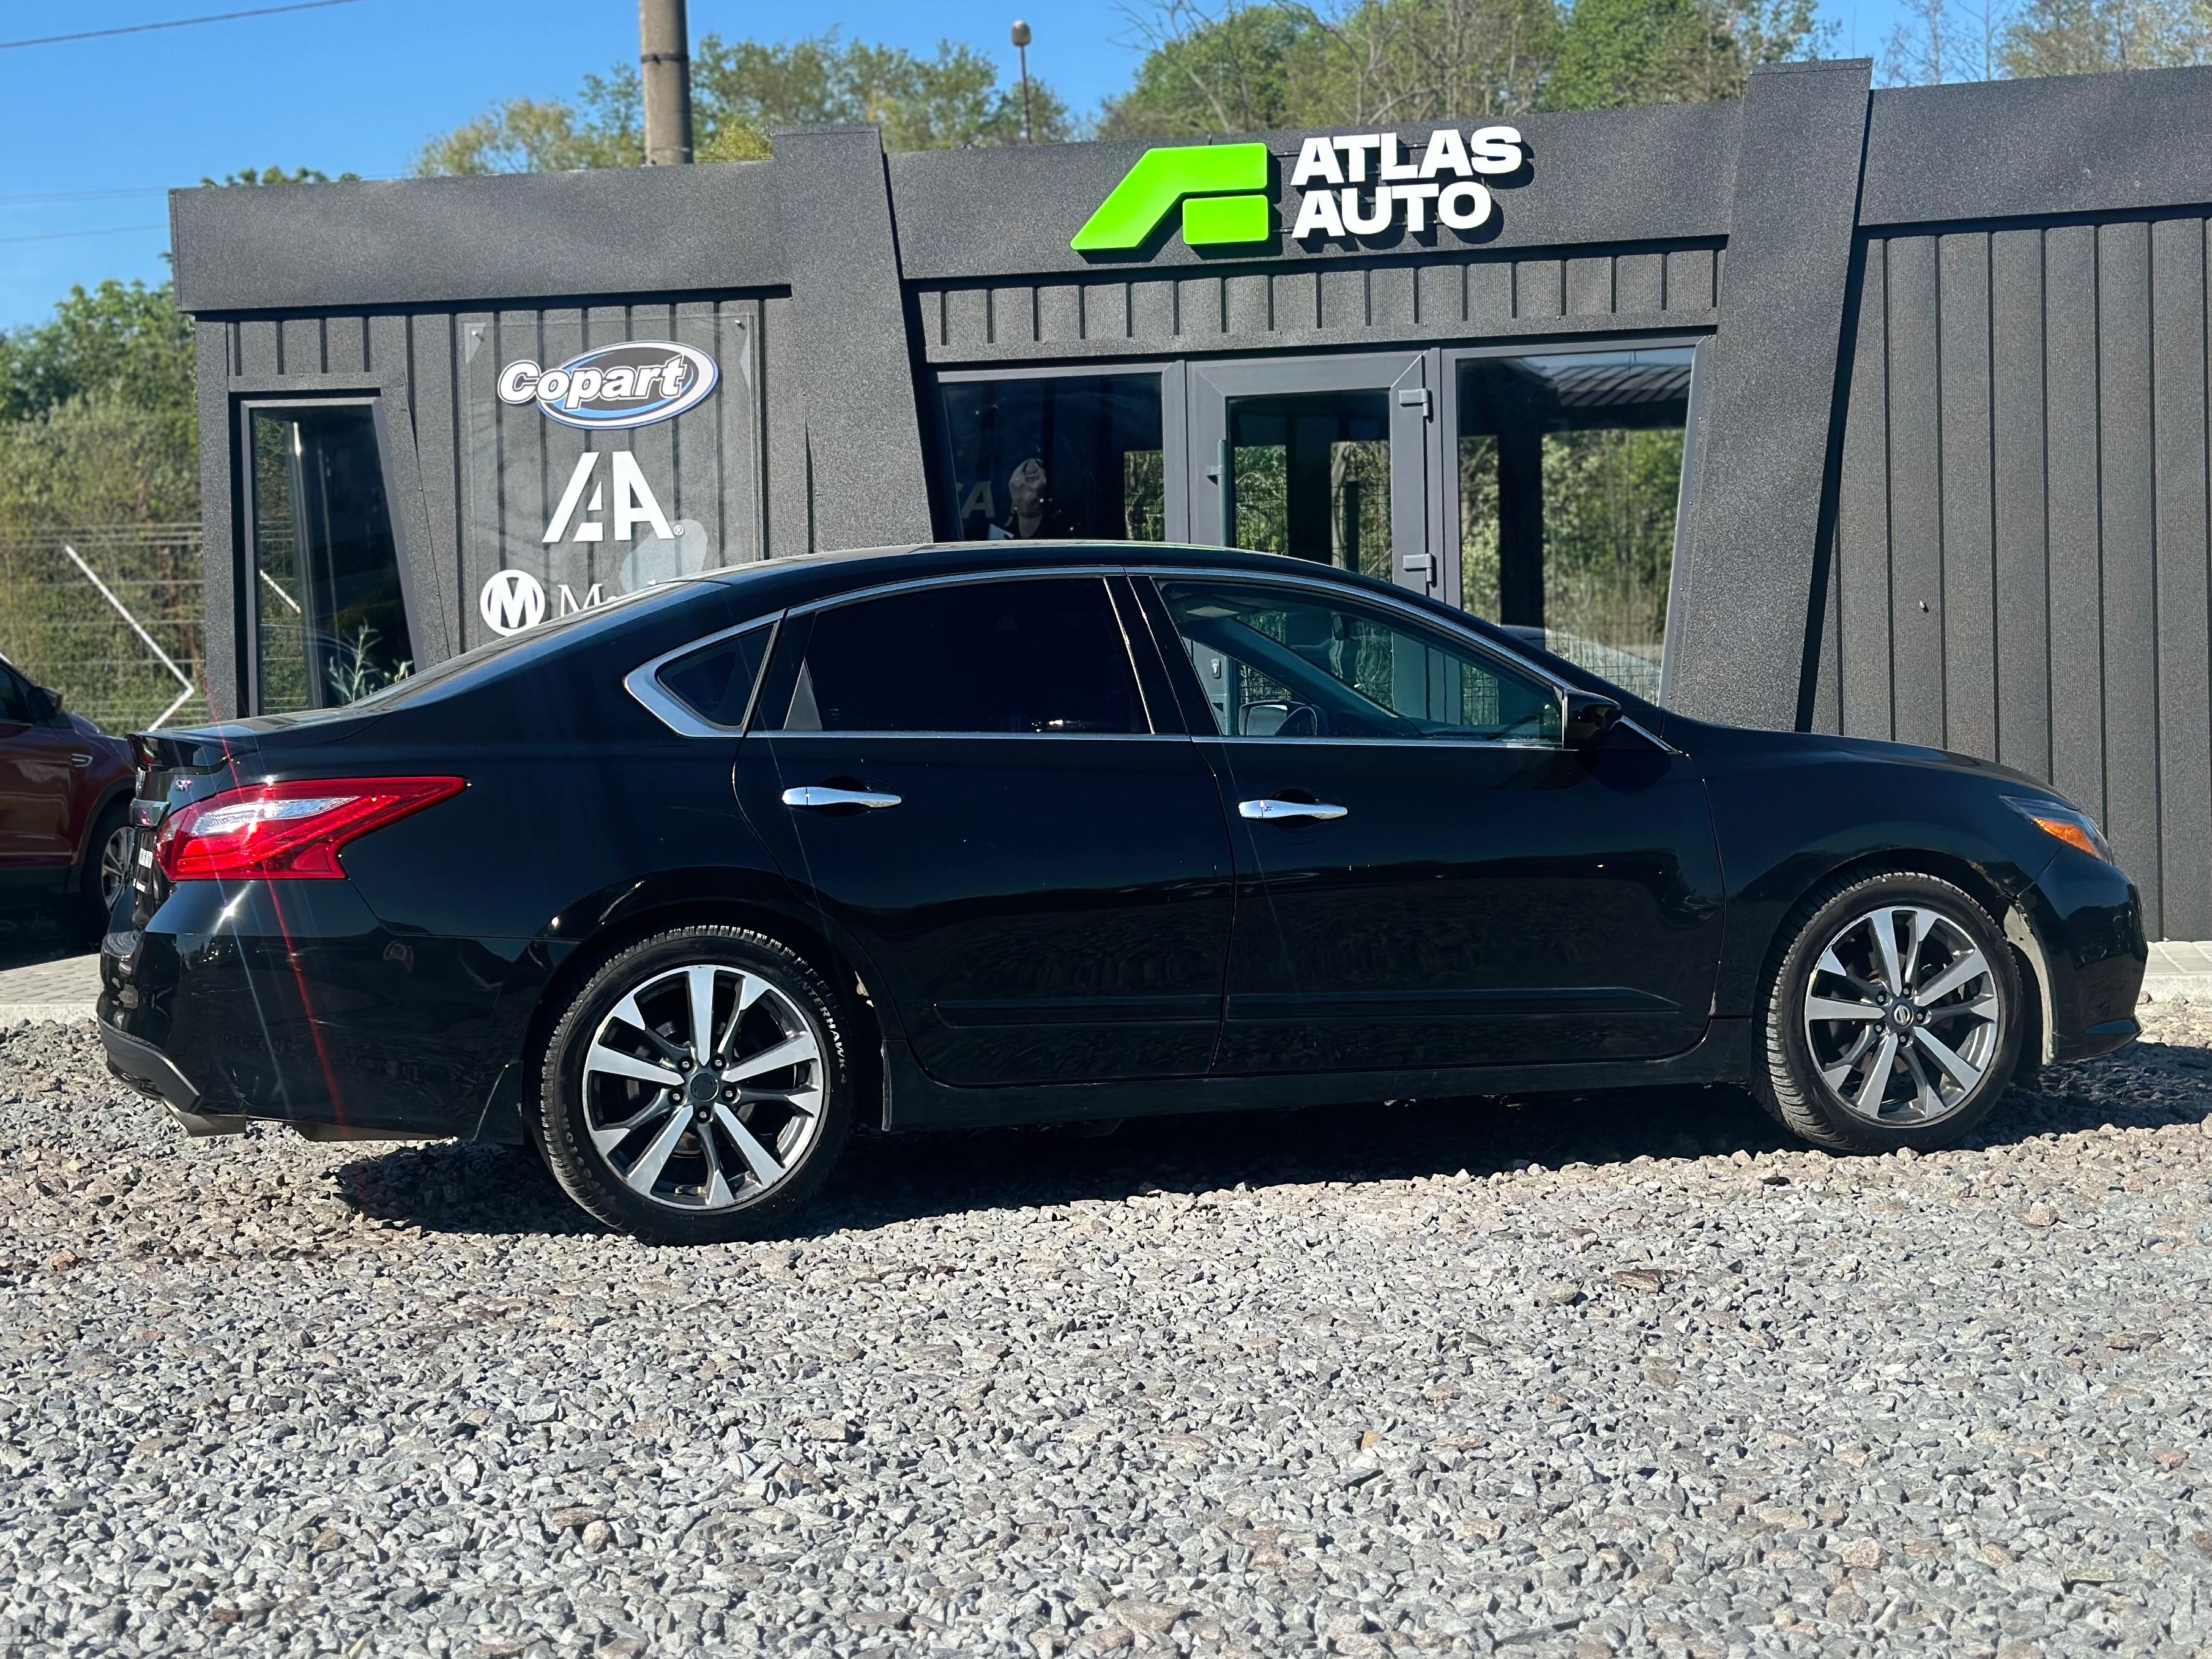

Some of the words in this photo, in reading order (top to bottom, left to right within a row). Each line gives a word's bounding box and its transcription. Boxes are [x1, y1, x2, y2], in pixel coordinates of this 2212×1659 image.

[1290, 126, 1522, 186] ATLAS
[1291, 182, 1492, 239] AUTO
[497, 354, 687, 411] Copart
[781, 964, 847, 1070] WINTERHAWK
